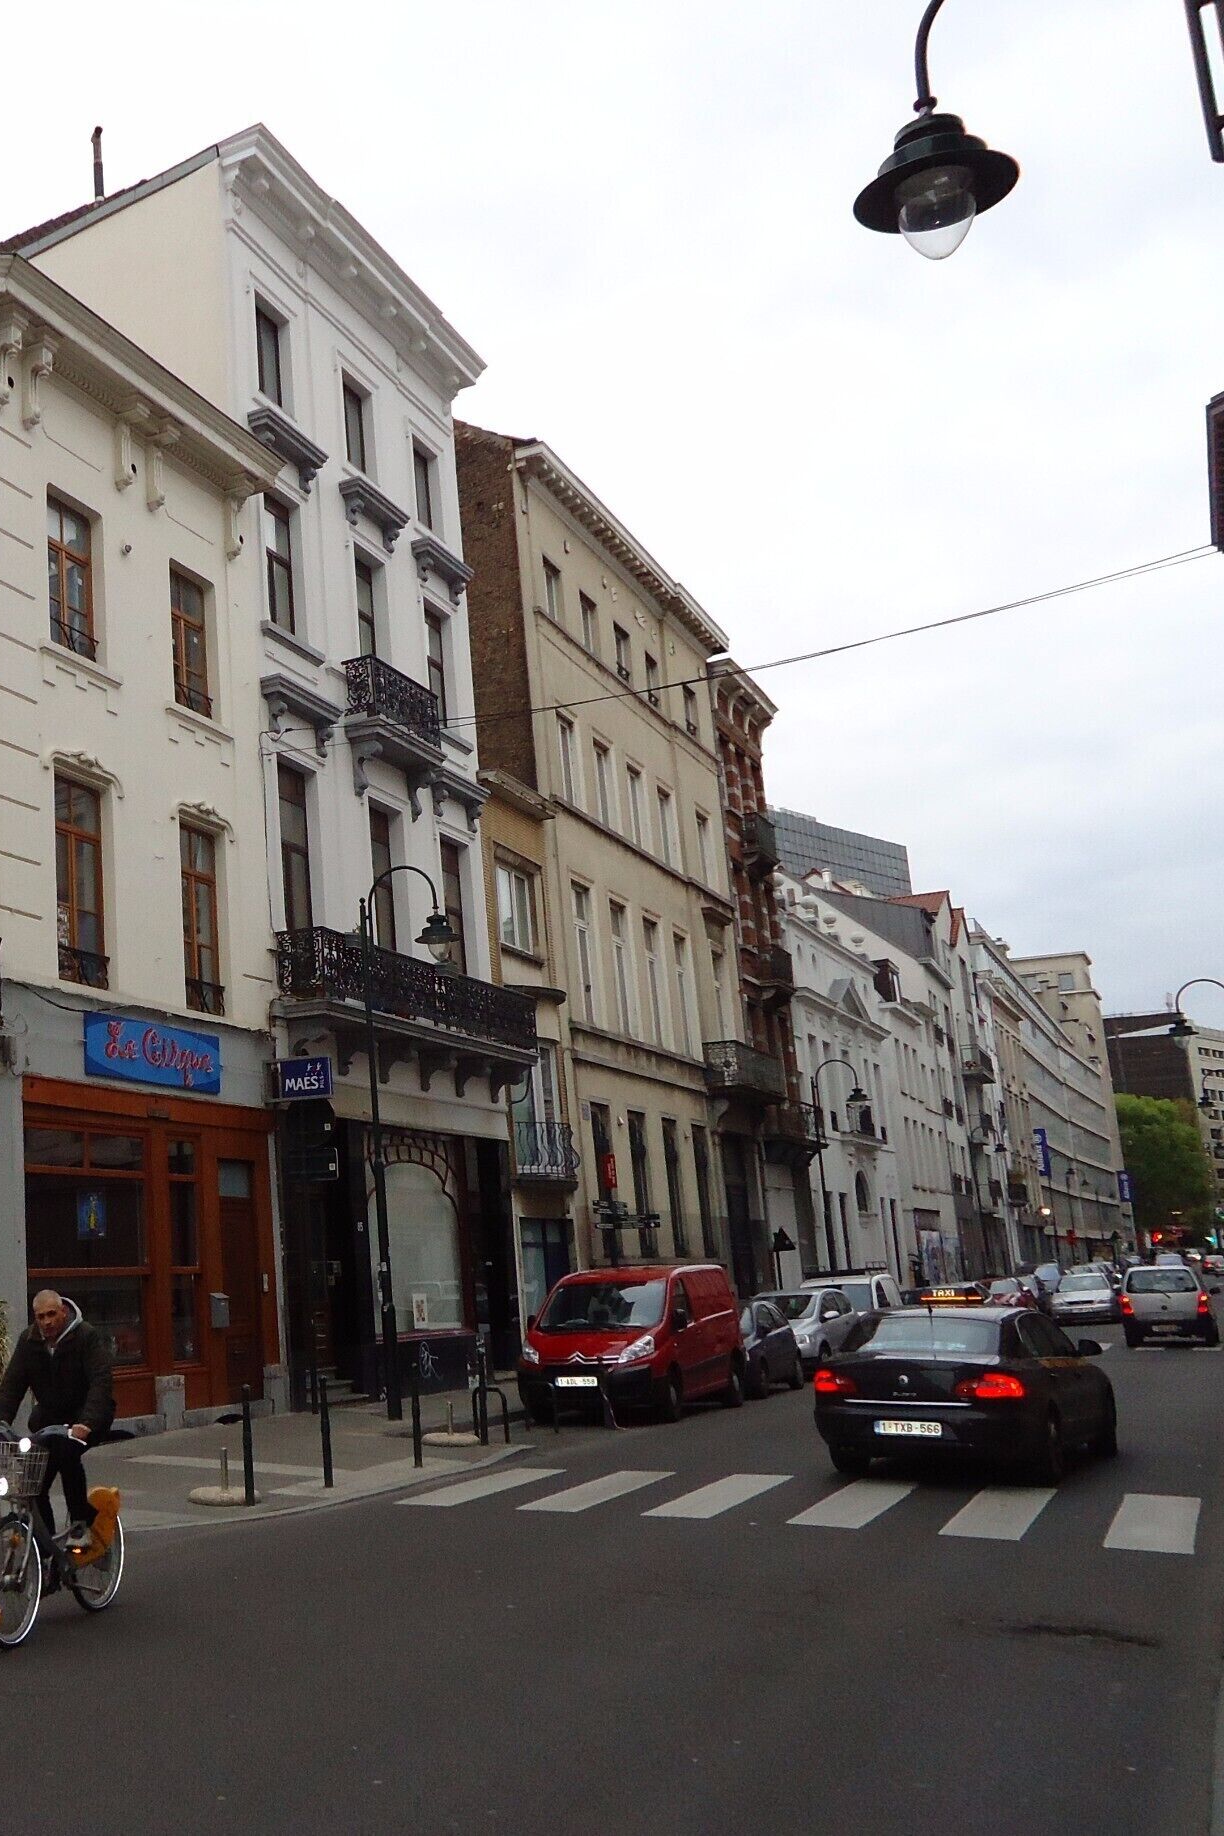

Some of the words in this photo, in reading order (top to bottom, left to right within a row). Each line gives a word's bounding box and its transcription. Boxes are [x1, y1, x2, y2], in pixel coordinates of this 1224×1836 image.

[105, 1021, 139, 1060] Le
[285, 1075, 319, 1092] MAES
[931, 1289, 955, 1297] TAXI
